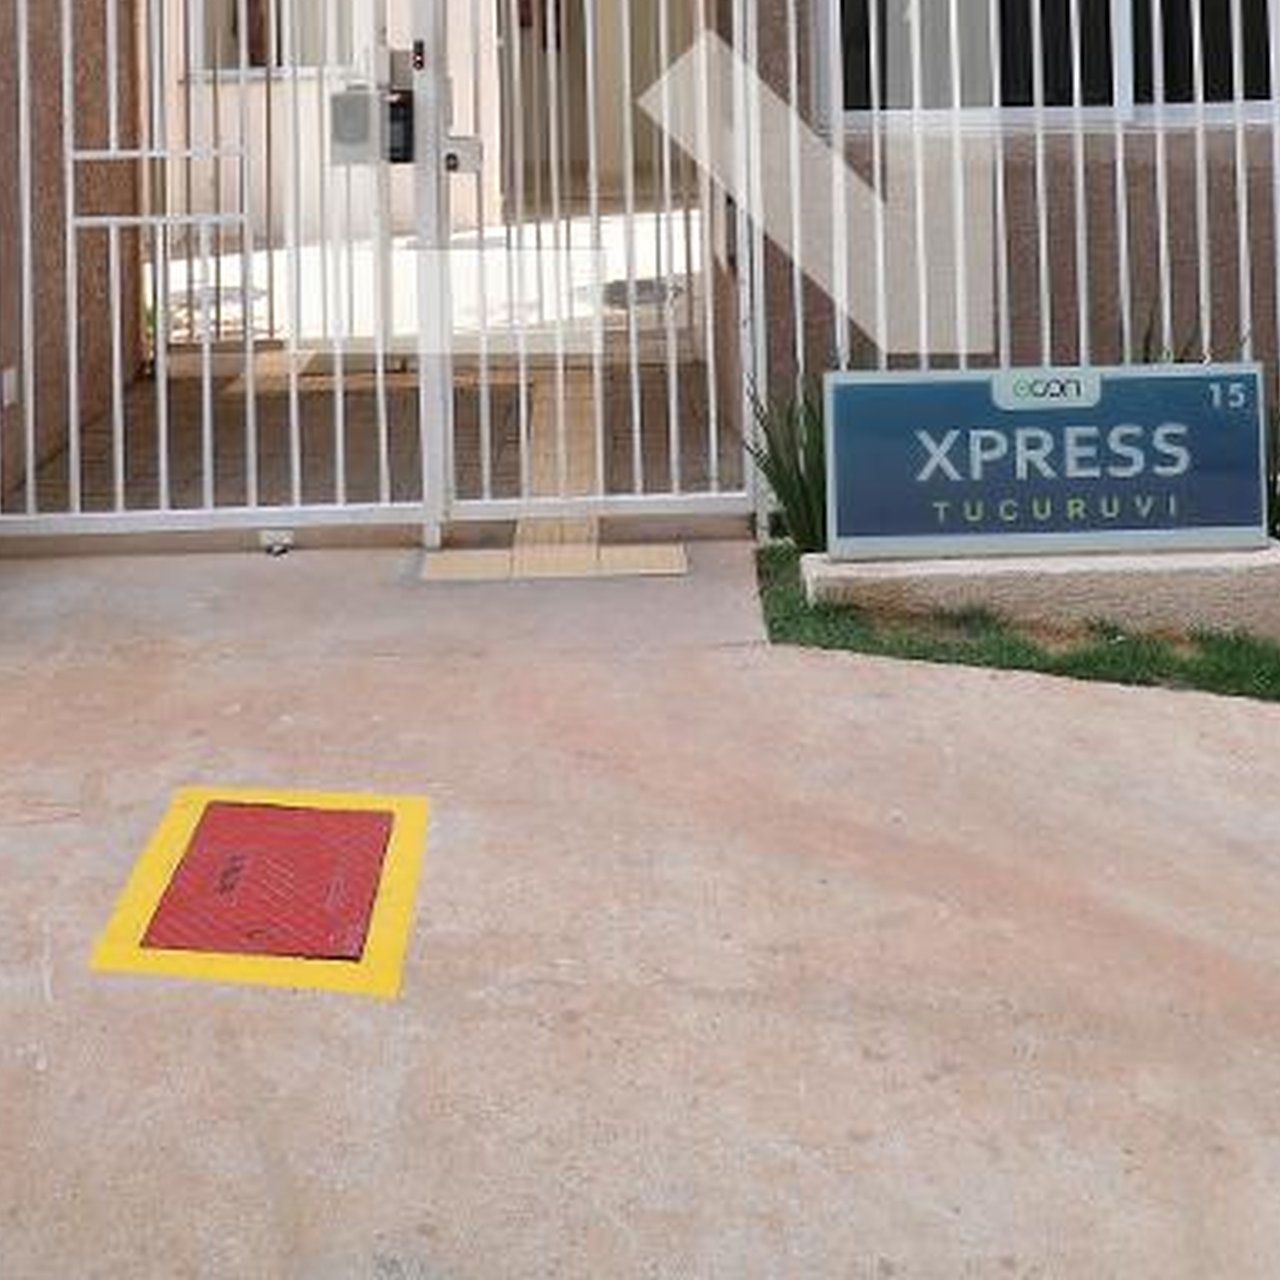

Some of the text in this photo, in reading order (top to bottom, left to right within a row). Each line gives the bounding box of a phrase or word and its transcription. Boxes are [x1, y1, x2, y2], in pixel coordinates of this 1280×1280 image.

[1209, 382, 1247, 409] 15
[916, 422, 1192, 483] XPRESS
[932, 495, 1177, 522] TUCURUVI
